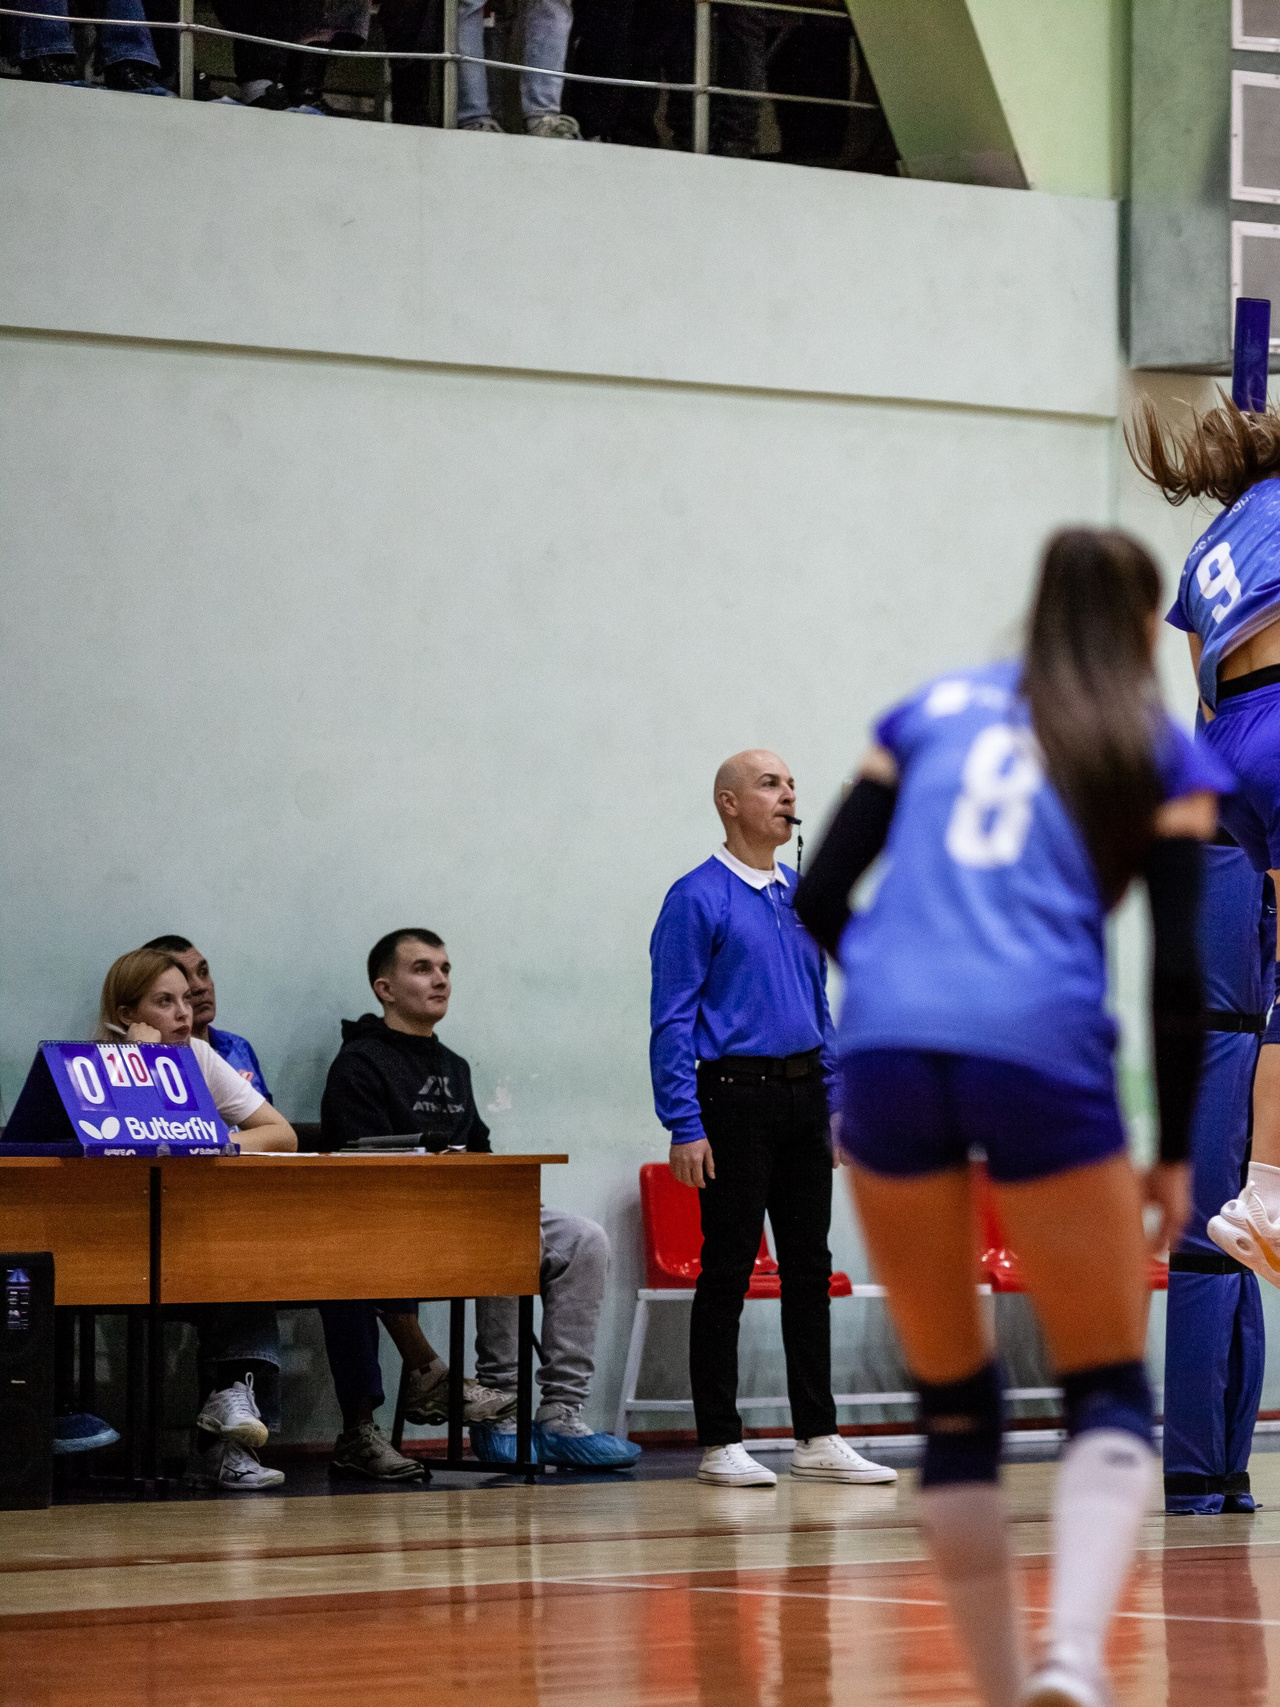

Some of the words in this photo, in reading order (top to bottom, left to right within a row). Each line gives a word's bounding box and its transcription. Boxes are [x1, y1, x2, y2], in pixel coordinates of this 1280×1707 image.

[1196, 542, 1242, 624] 9
[946, 725, 1046, 867] 8
[72, 1056, 105, 1105] 0
[155, 1056, 188, 1104] 0
[124, 1117, 218, 1143] Butterfly
